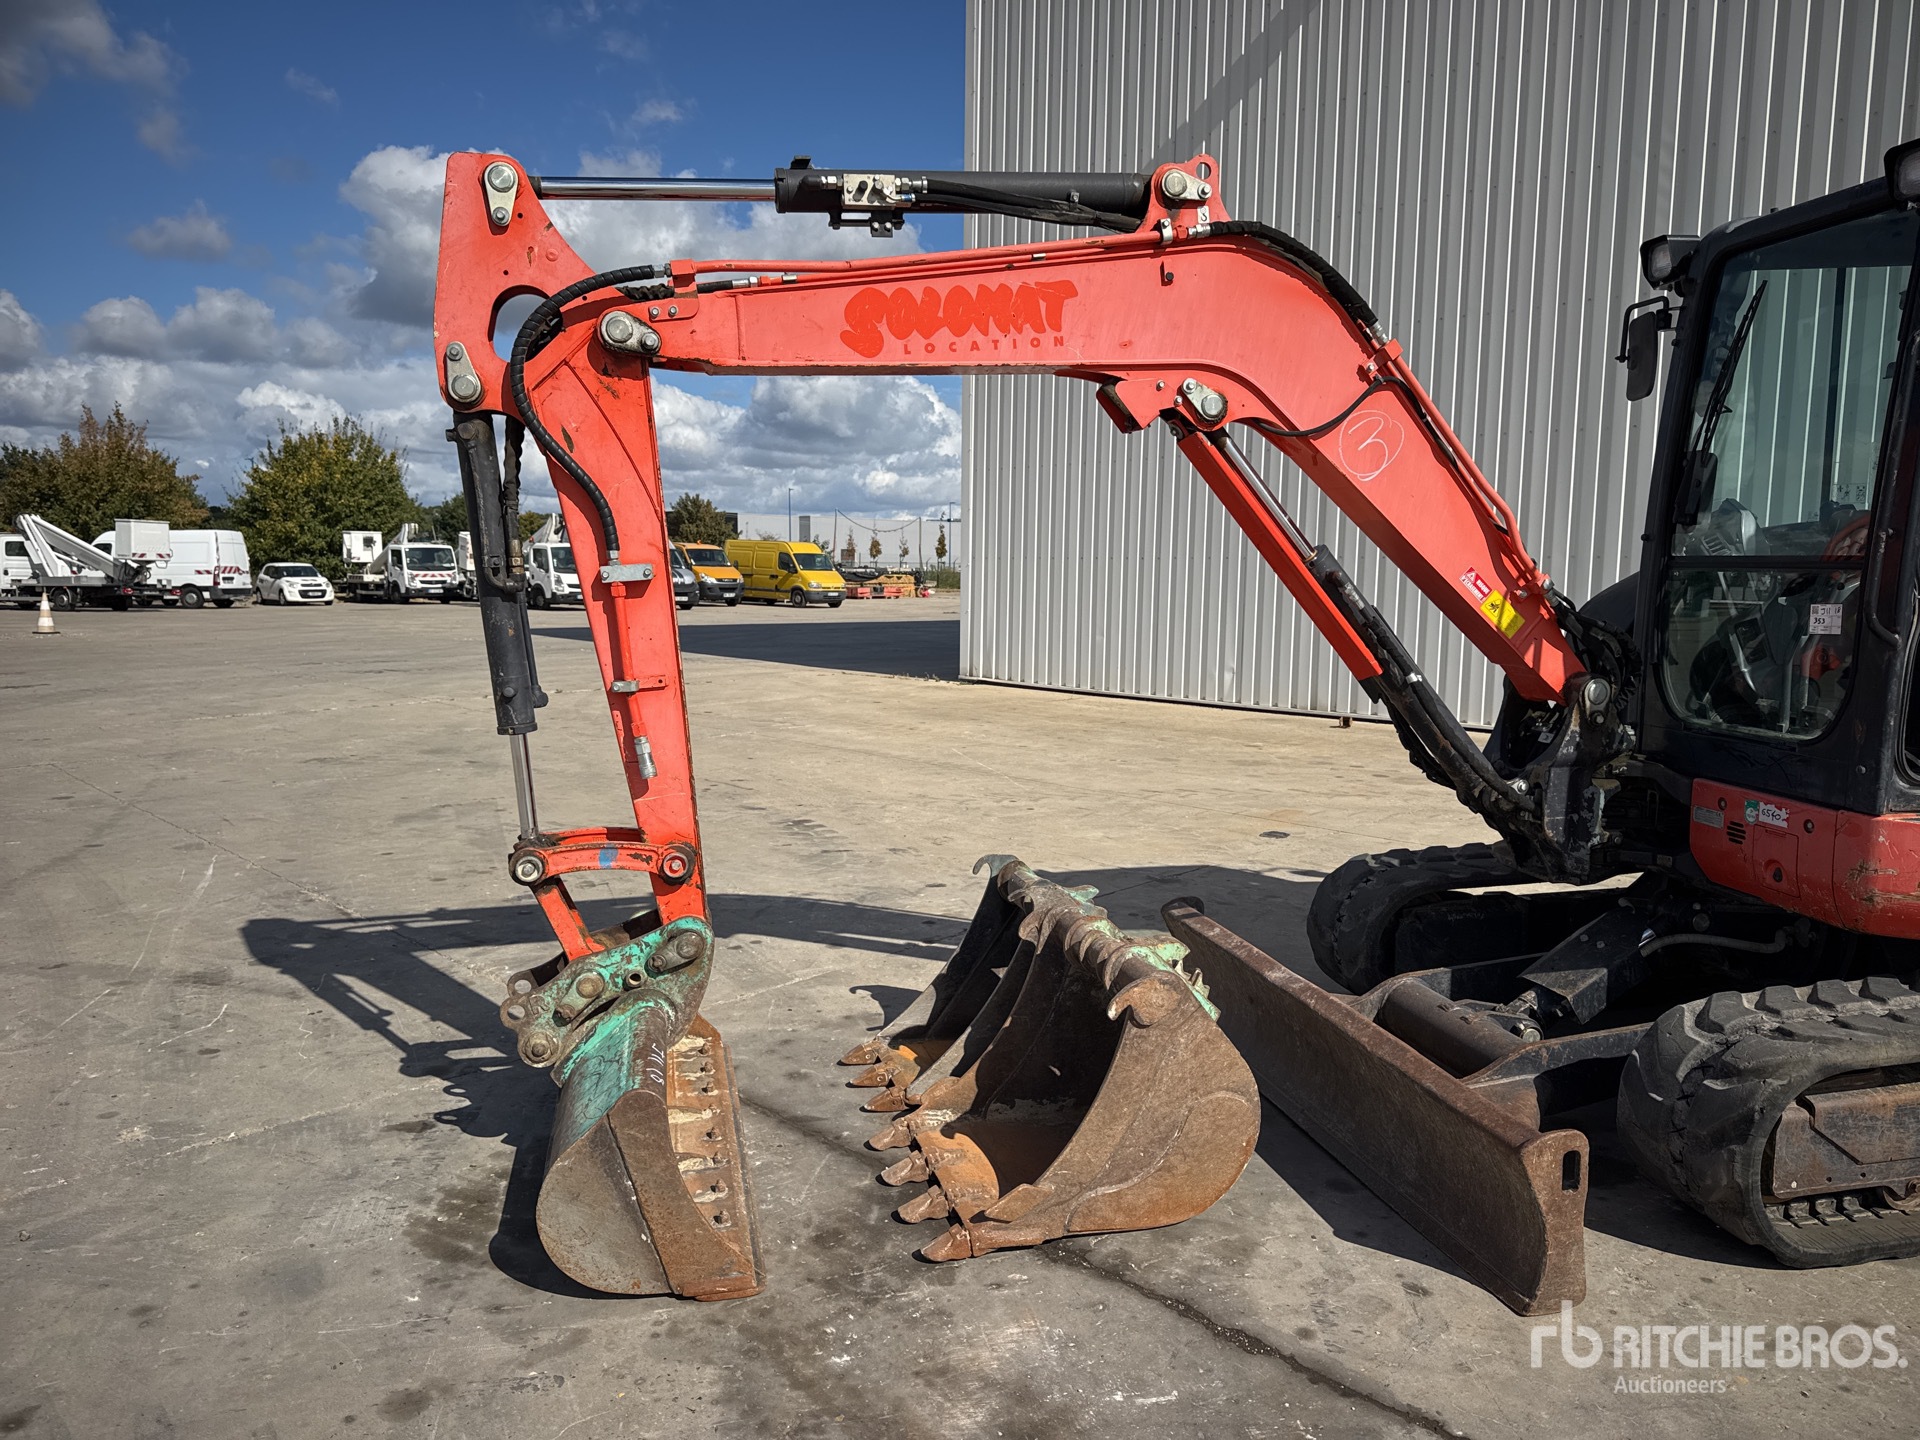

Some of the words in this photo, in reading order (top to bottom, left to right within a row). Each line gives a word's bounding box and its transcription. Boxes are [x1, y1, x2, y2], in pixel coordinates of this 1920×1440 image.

[903, 335, 1064, 355] LOCATION
[1347, 416, 1388, 482] 3
[1813, 617, 1826, 625] 353
[1761, 808, 1781, 821] 6540
